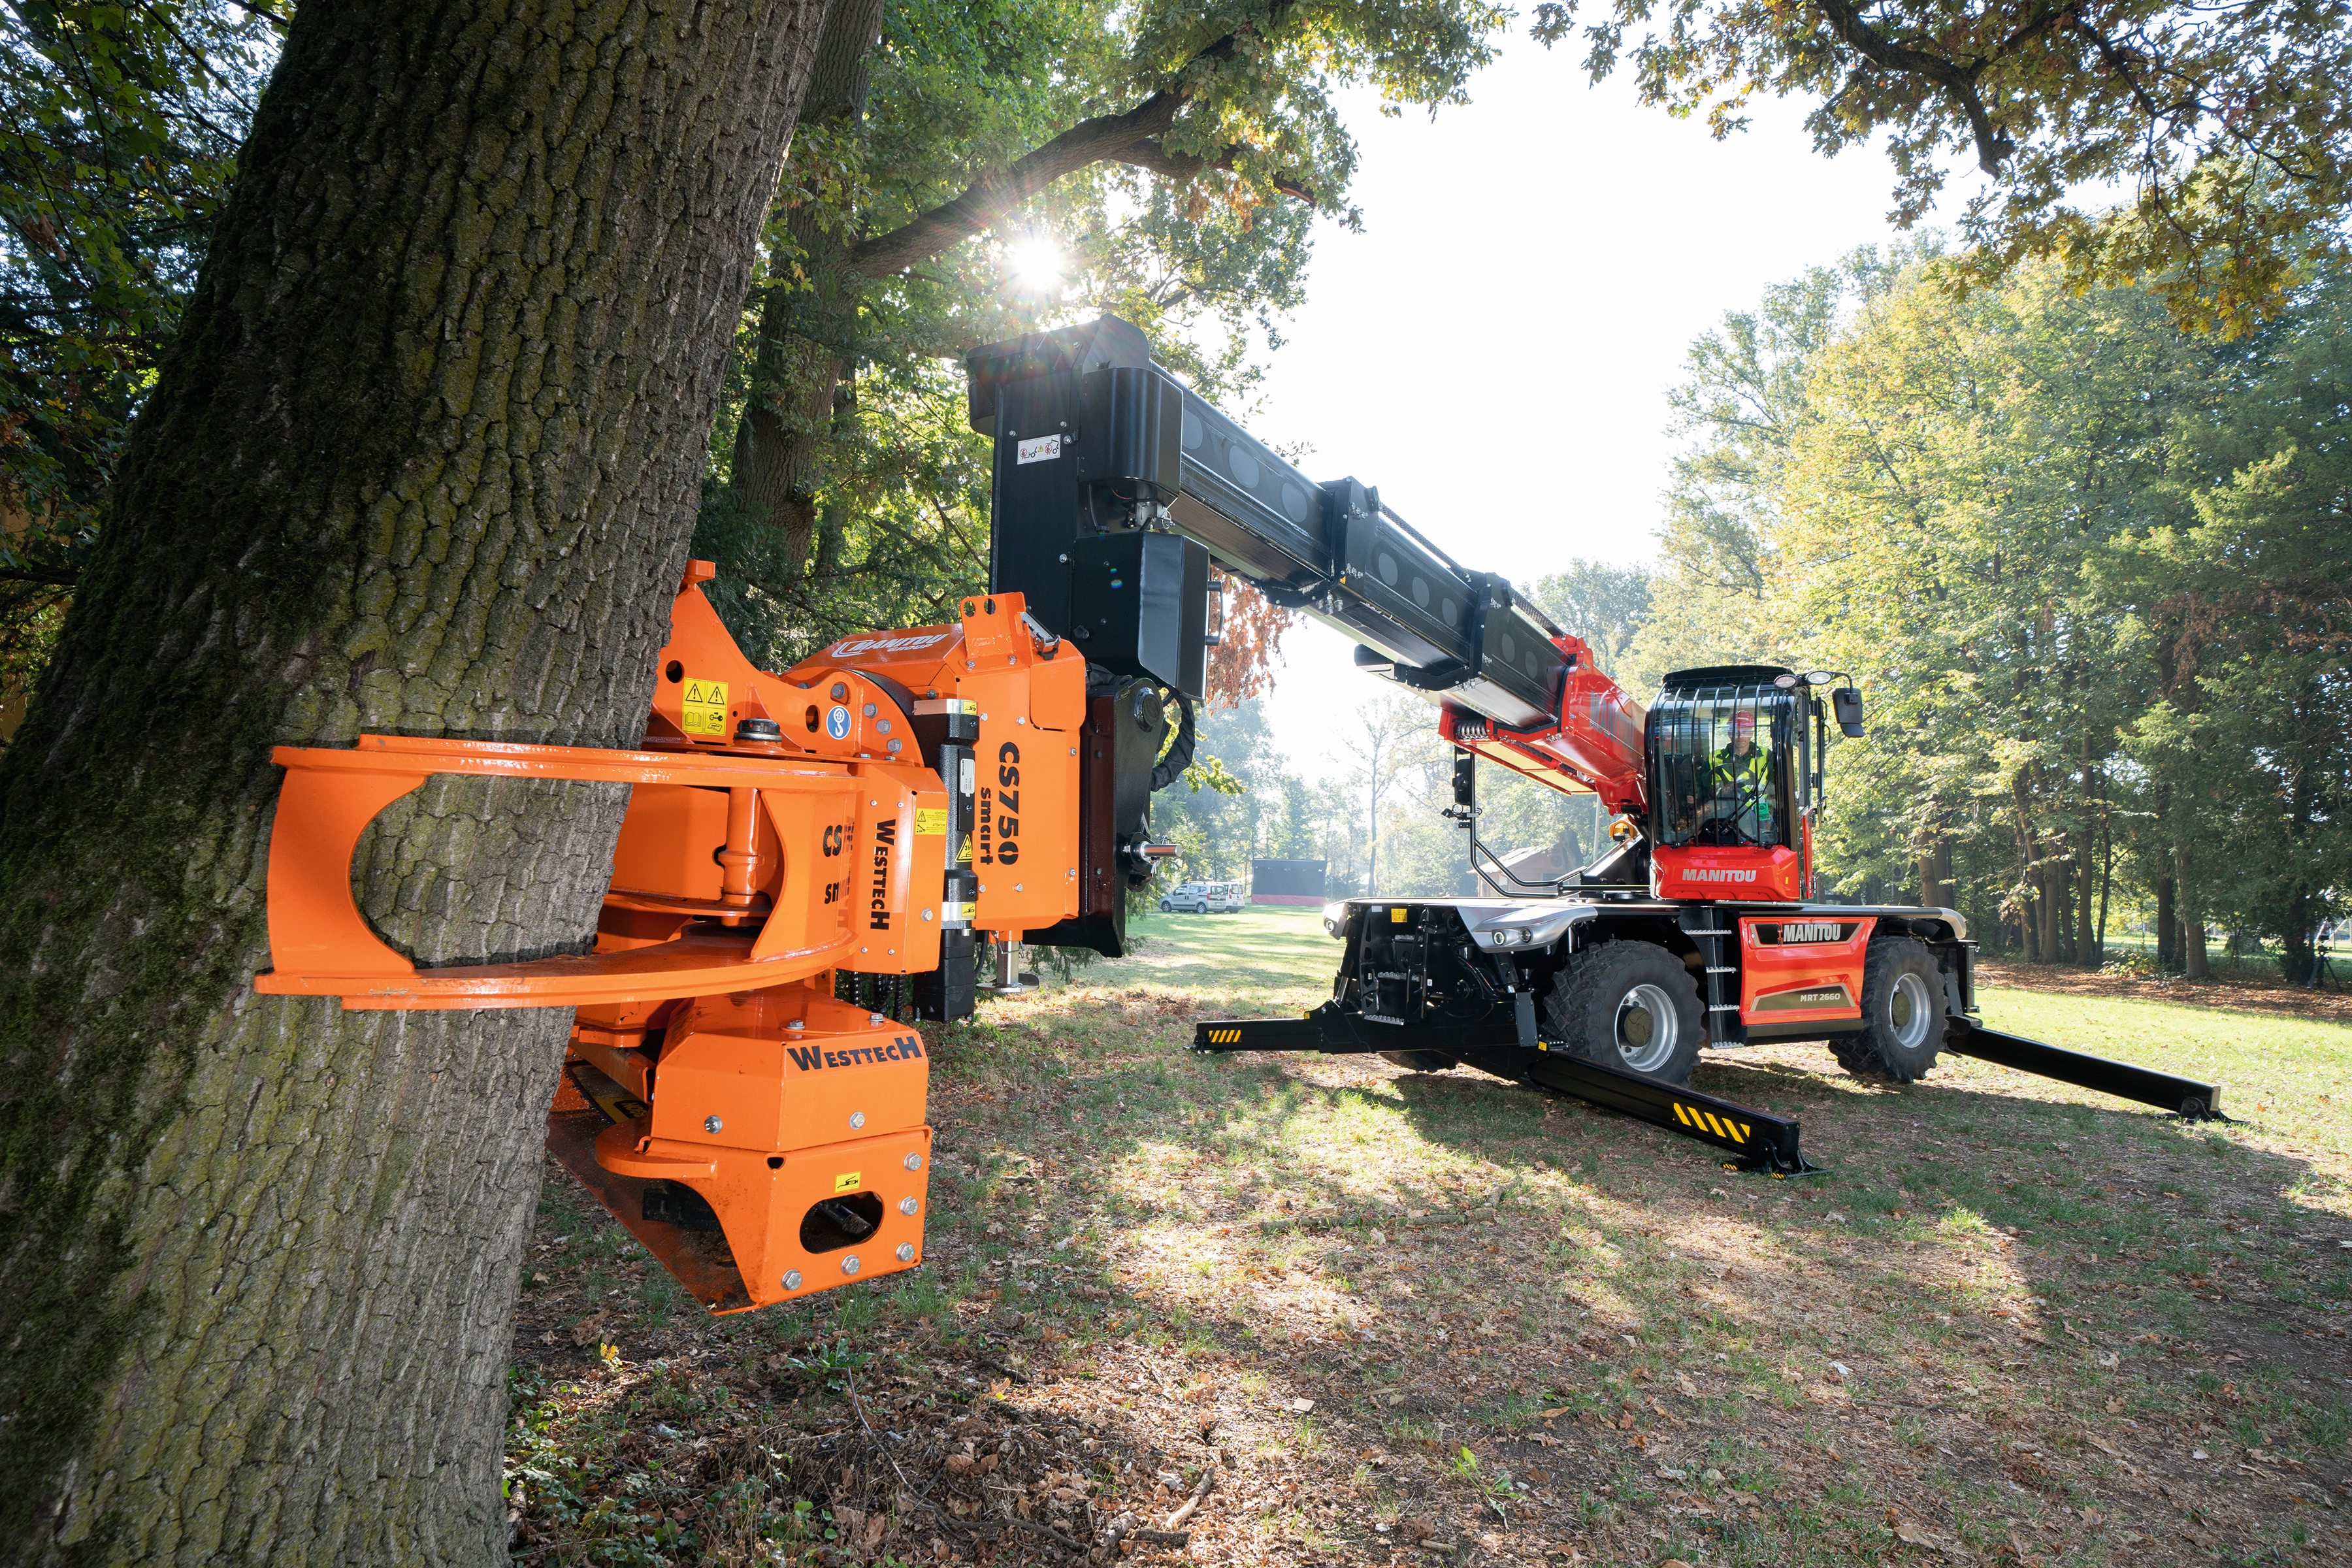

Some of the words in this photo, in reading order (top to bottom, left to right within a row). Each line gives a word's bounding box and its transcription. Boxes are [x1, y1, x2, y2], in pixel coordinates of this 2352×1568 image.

[847, 634, 950, 652] MANITOU
[887, 644, 933, 652] GROUP
[1590, 690, 1635, 753] MANITOU
[999, 742, 1019, 865] CS750
[823, 824, 843, 857] CS
[981, 787, 993, 864] smart
[870, 819, 896, 930] WESTTECH
[1682, 868, 1757, 882] MANITOU
[1783, 923, 1841, 943] MANITOU
[1800, 994, 1818, 1002] MRT
[1820, 992, 1841, 1002] 2660
[787, 1036, 922, 1071] WESTTECH
